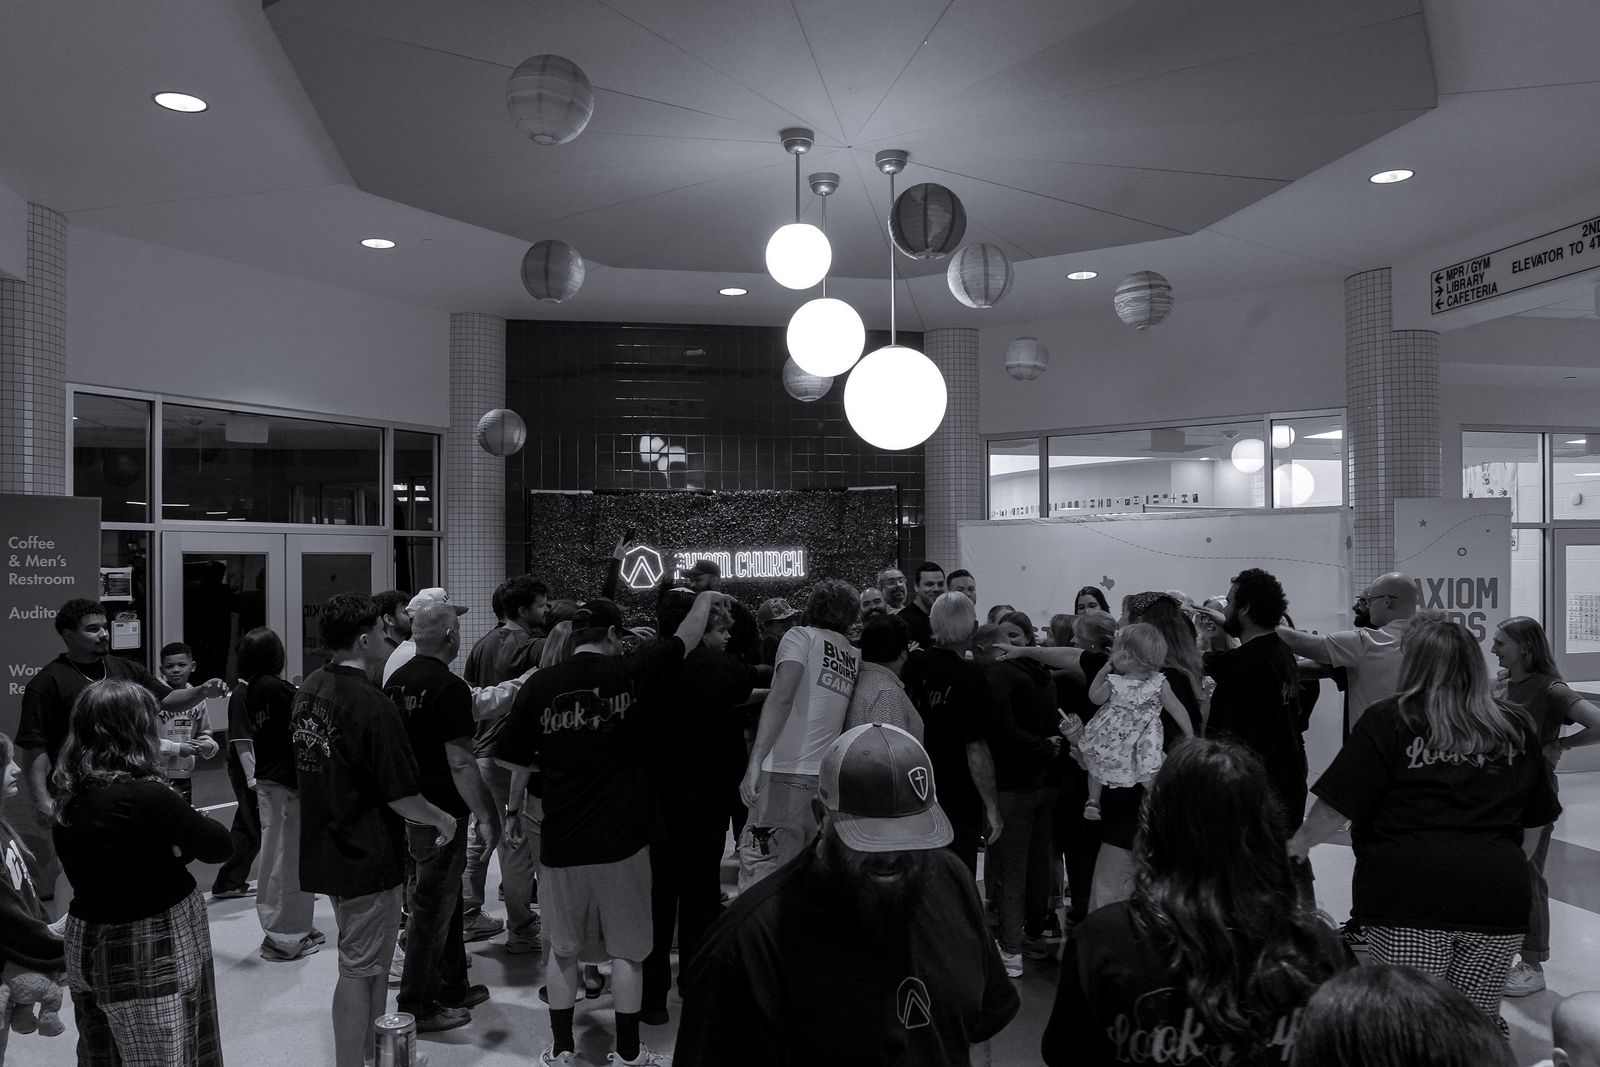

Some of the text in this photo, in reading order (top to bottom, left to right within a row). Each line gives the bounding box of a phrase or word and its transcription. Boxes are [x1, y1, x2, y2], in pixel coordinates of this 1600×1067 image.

[1512, 247, 1564, 273] ELEVATOR
[1569, 241, 1584, 256] TO
[1447, 271, 1485, 293] LIBRARY
[1447, 282, 1498, 306] CAFETERIA
[8, 536, 55, 550] Coffee
[8, 554, 67, 567] & Men's
[735, 550, 805, 578] CHURCH
[9, 573, 75, 585] Restroom
[540, 701, 586, 735] Look
[1106, 1007, 1206, 1064] Look
